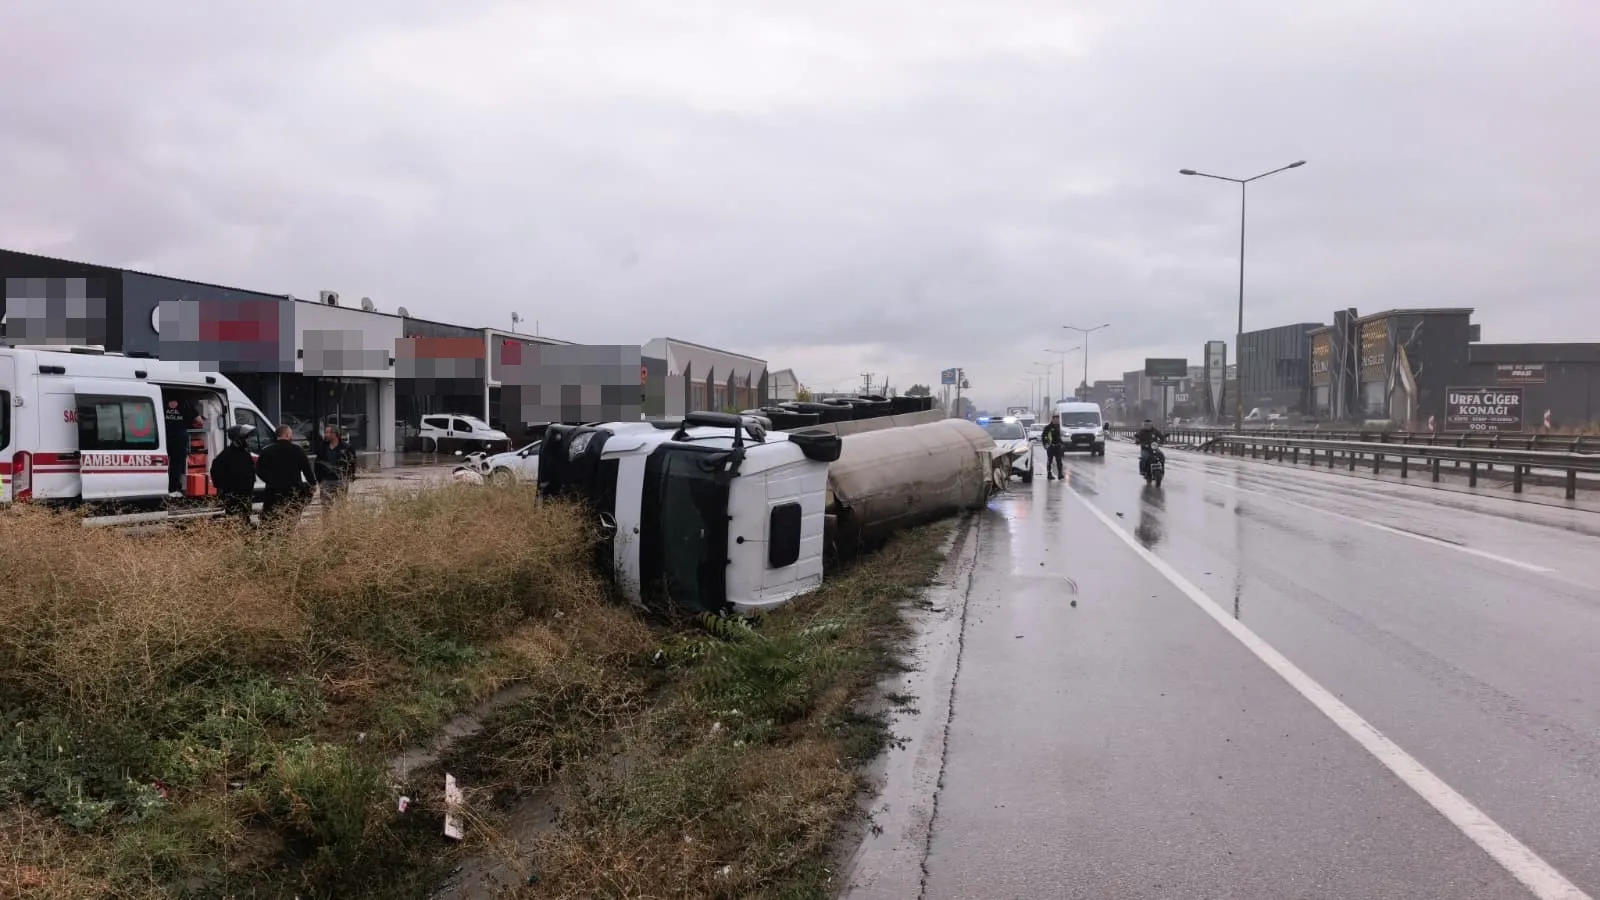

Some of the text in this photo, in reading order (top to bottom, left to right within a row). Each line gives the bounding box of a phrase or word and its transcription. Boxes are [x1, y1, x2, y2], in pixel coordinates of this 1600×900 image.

[1449, 391, 1519, 405] URFA CİĞER
[1459, 404, 1508, 415] KONAĞI
[83, 454, 152, 467] AMBULANS
